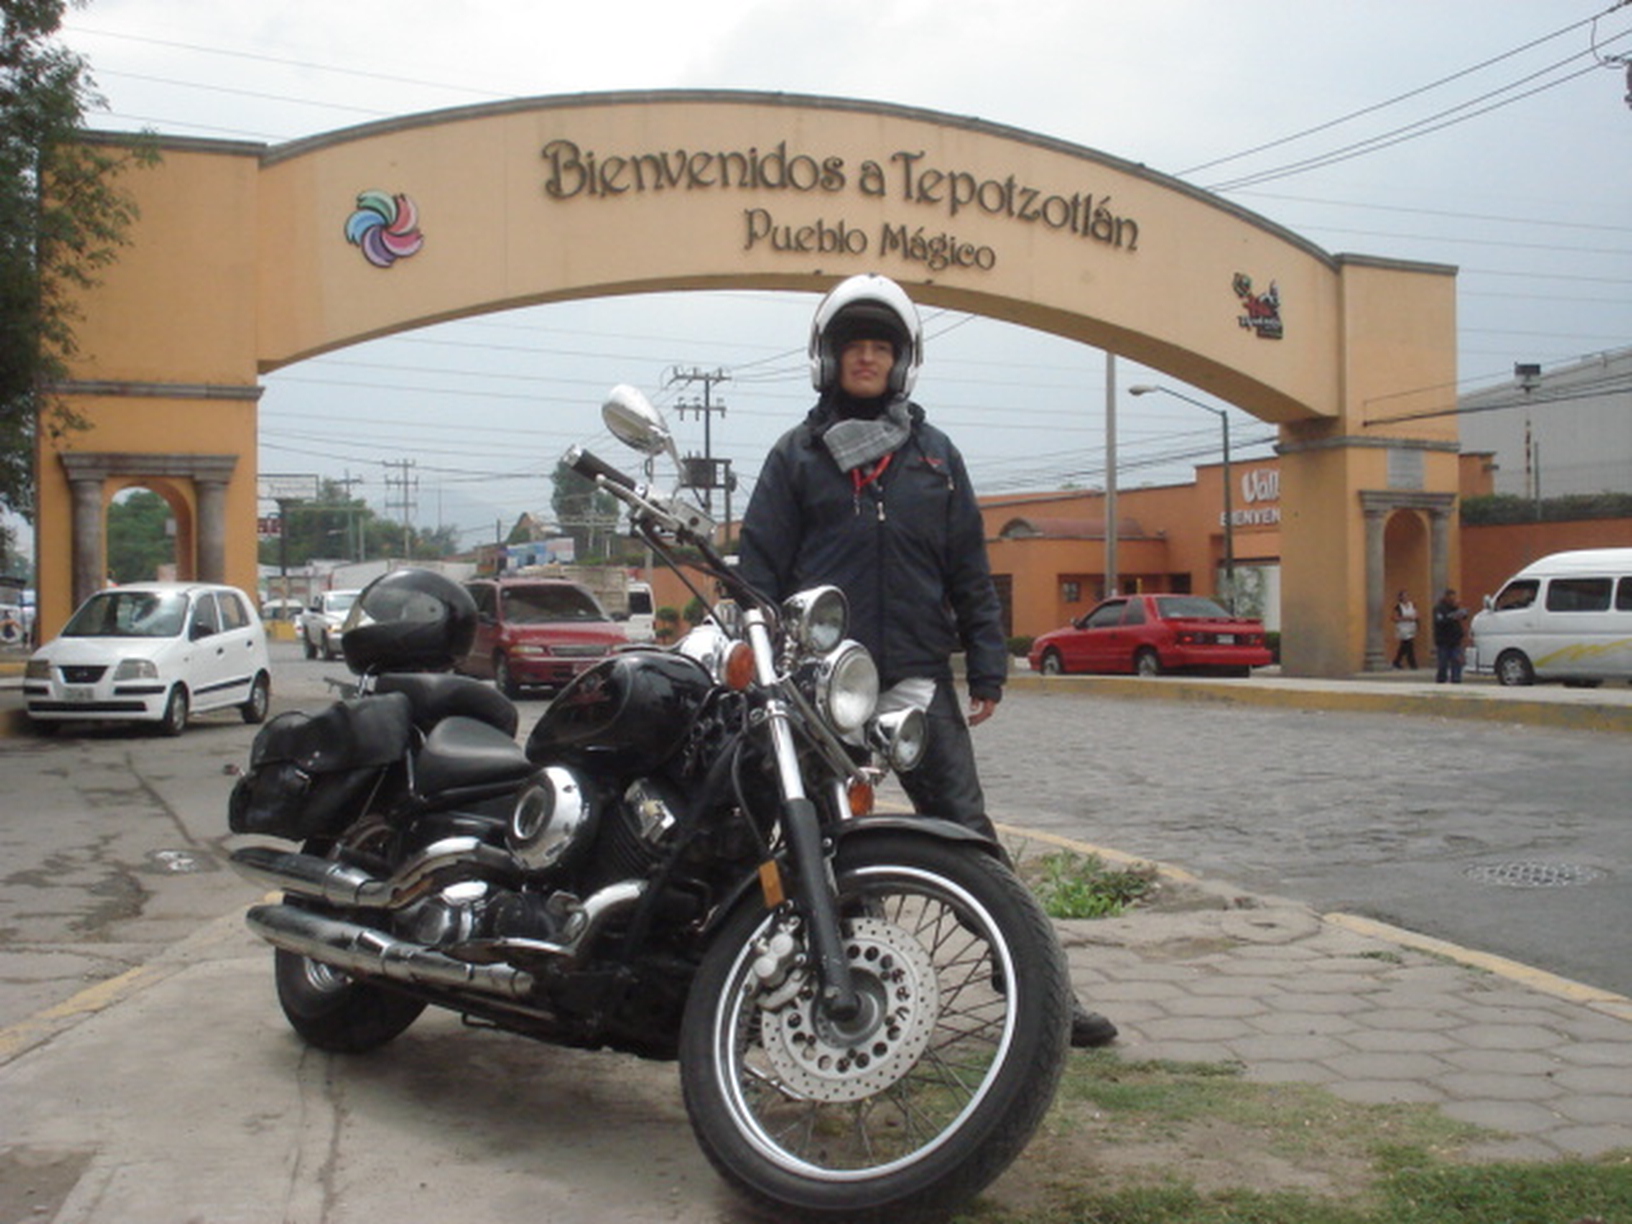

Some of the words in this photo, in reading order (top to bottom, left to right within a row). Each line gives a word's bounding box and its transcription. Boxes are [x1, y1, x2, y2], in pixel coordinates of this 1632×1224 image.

[541, 139, 846, 200] Bienvenidos
[859, 160, 886, 197] a
[891, 150, 1139, 252] Tepotzotlán
[744, 207, 868, 255] Pueblo
[879, 222, 996, 271] Mágico
